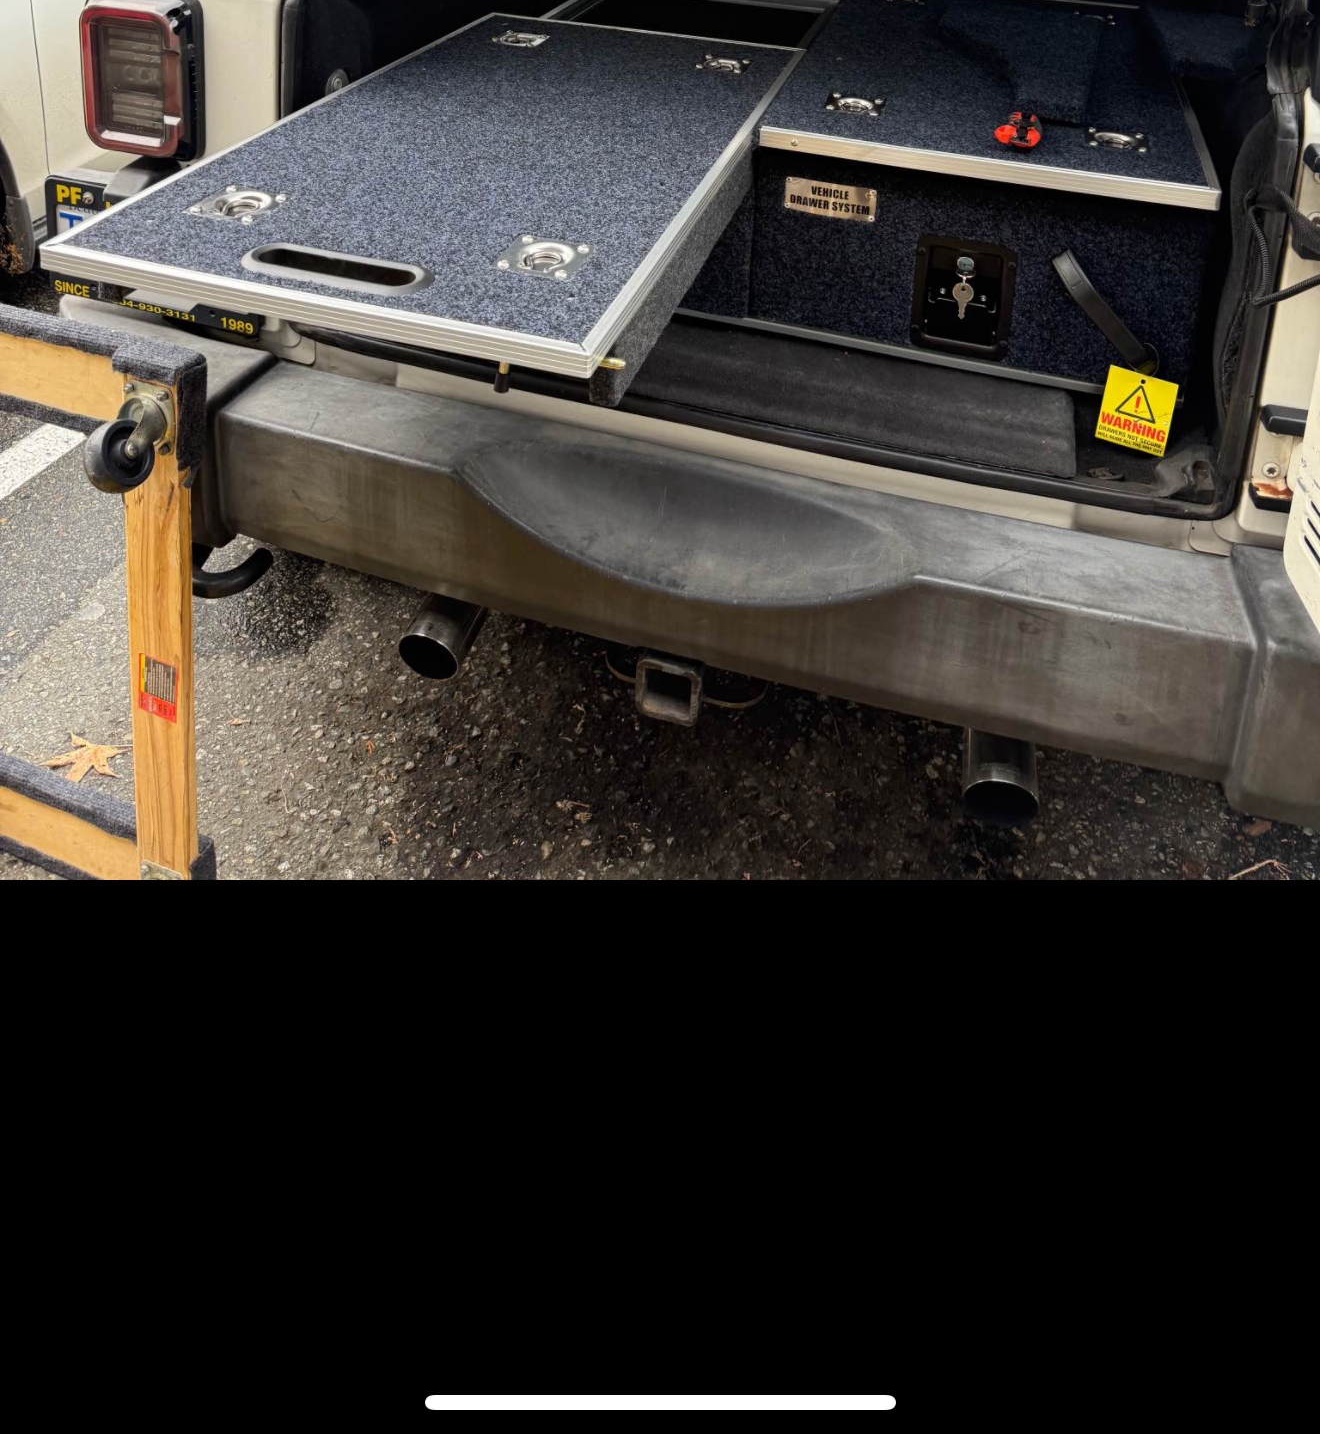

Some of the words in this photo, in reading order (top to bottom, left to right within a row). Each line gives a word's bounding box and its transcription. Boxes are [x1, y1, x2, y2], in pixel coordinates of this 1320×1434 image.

[811, 186, 849, 200] VEHICLE
[790, 194, 829, 210] DRAWER
[832, 202, 870, 215] SYSTEM
[54, 280, 90, 297] SINCE
[220, 317, 254, 334] 1989
[1099, 425, 1126, 437] DRAWERS
[1127, 434, 1139, 442] NOT
[1101, 412, 1166, 442] WARNING
